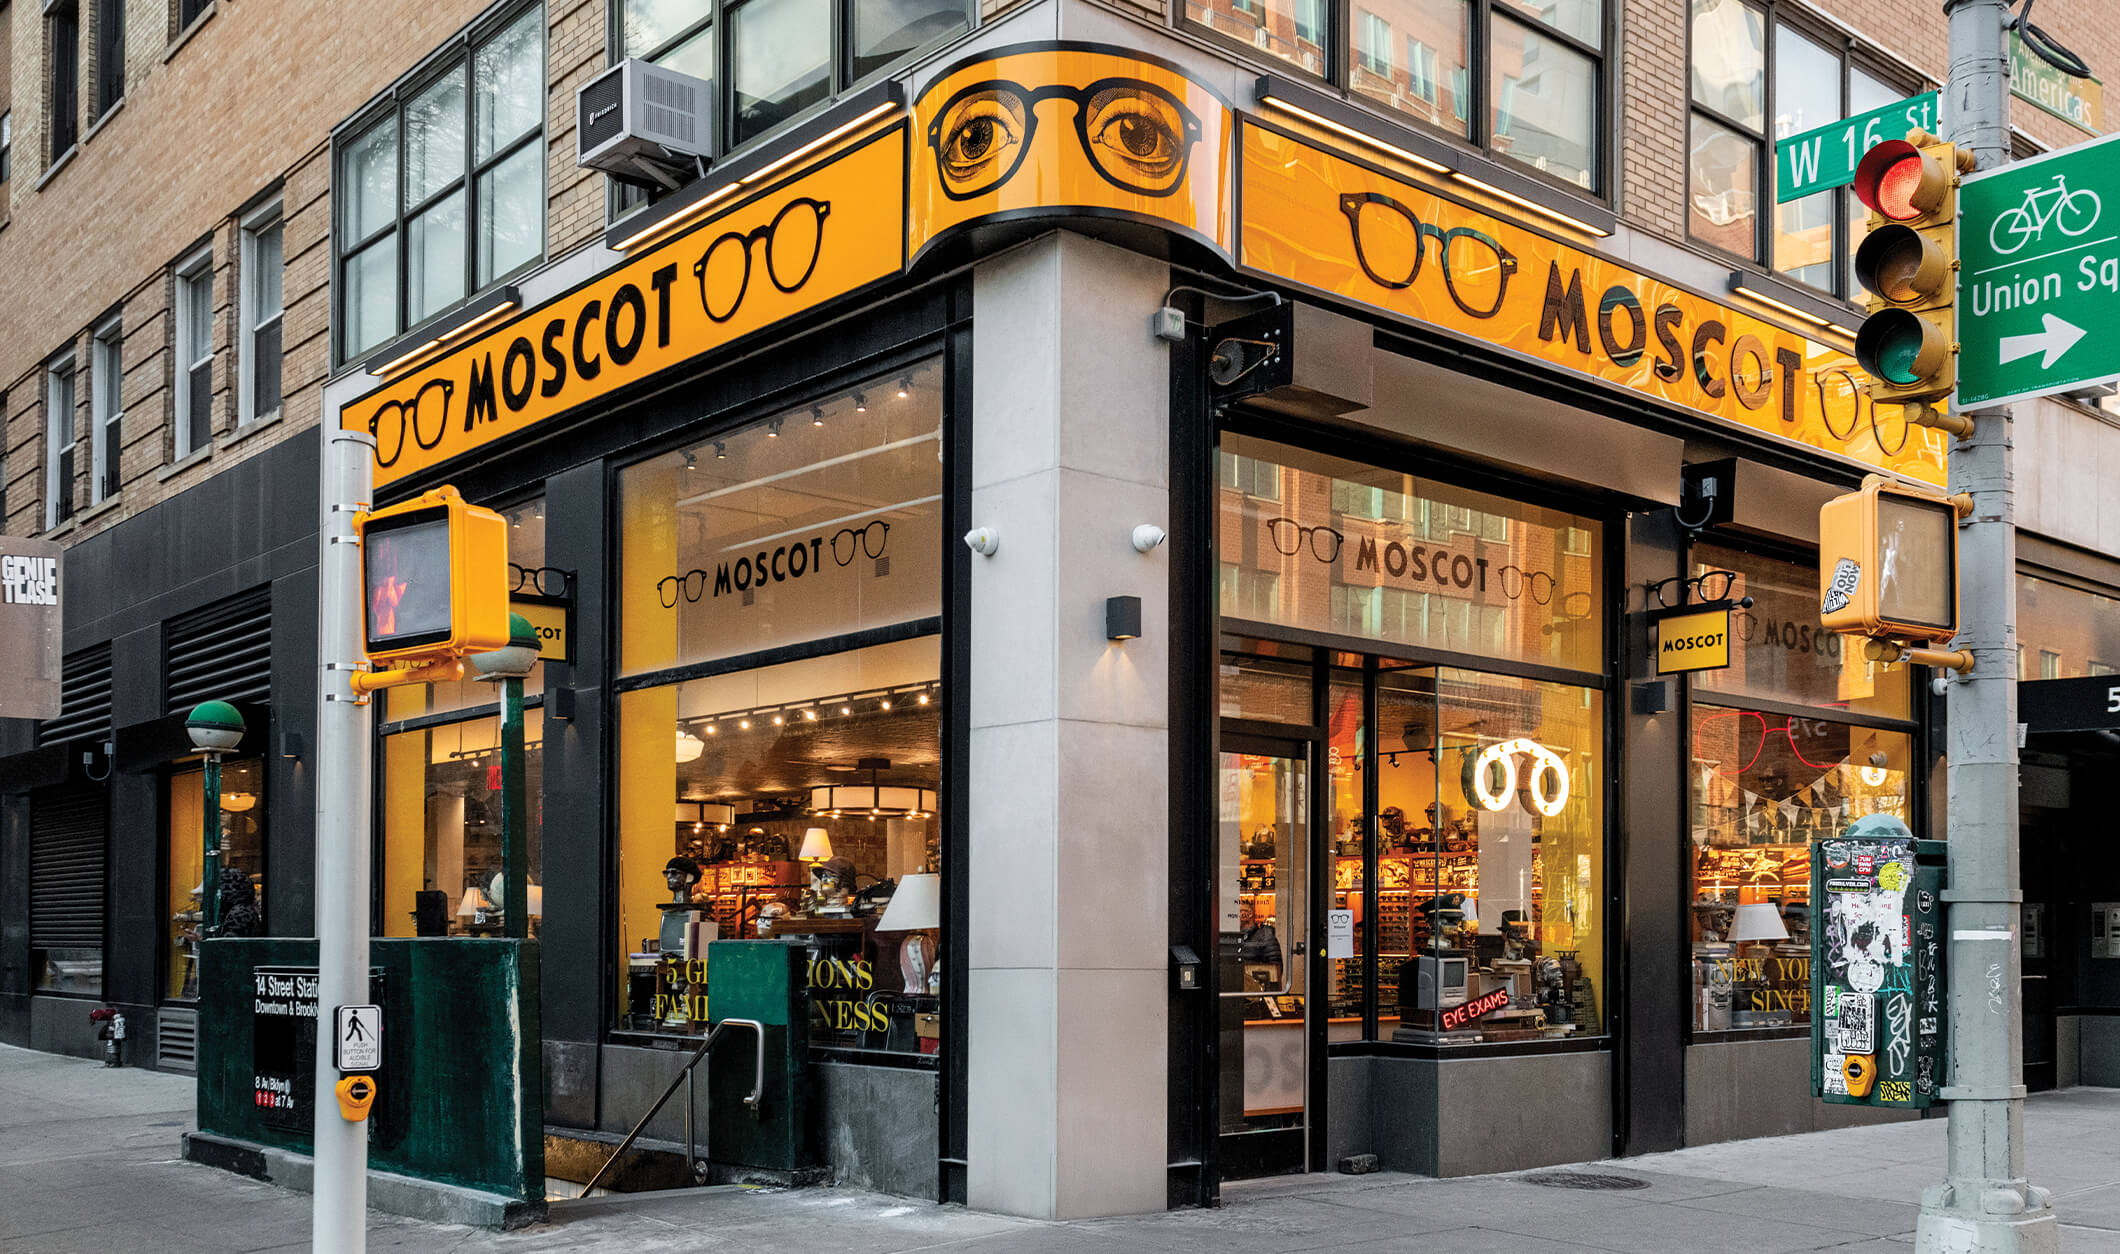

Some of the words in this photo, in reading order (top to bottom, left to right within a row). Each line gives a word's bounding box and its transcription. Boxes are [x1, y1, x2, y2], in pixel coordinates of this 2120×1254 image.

[2009, 55, 2093, 128] Americas
[1789, 136, 1823, 188] W
[1841, 117, 1884, 172] 16
[1905, 101, 1931, 134] St
[1973, 273, 2061, 316] Union
[2077, 255, 2119, 293] Sq
[464, 262, 677, 432] MOSCOT
[1538, 260, 1801, 422] MOSCOT
[2, 555, 56, 581] GENIE
[713, 537, 822, 597] MOSCOT
[1356, 535, 1489, 592] MOSCOT
[1663, 633, 1723, 652] MOSCOT
[256, 976, 266, 996] 14
[268, 976, 294, 998] Street
[296, 977, 319, 998] Stati
[666, 957, 677, 984] 5
[1715, 957, 1766, 982] NEW
[255, 999, 288, 1015] Downtown
[1443, 1006, 1467, 1029] EYE
[1467, 990, 1509, 1018] EXAMS
[255, 1076, 261, 1089] 8
